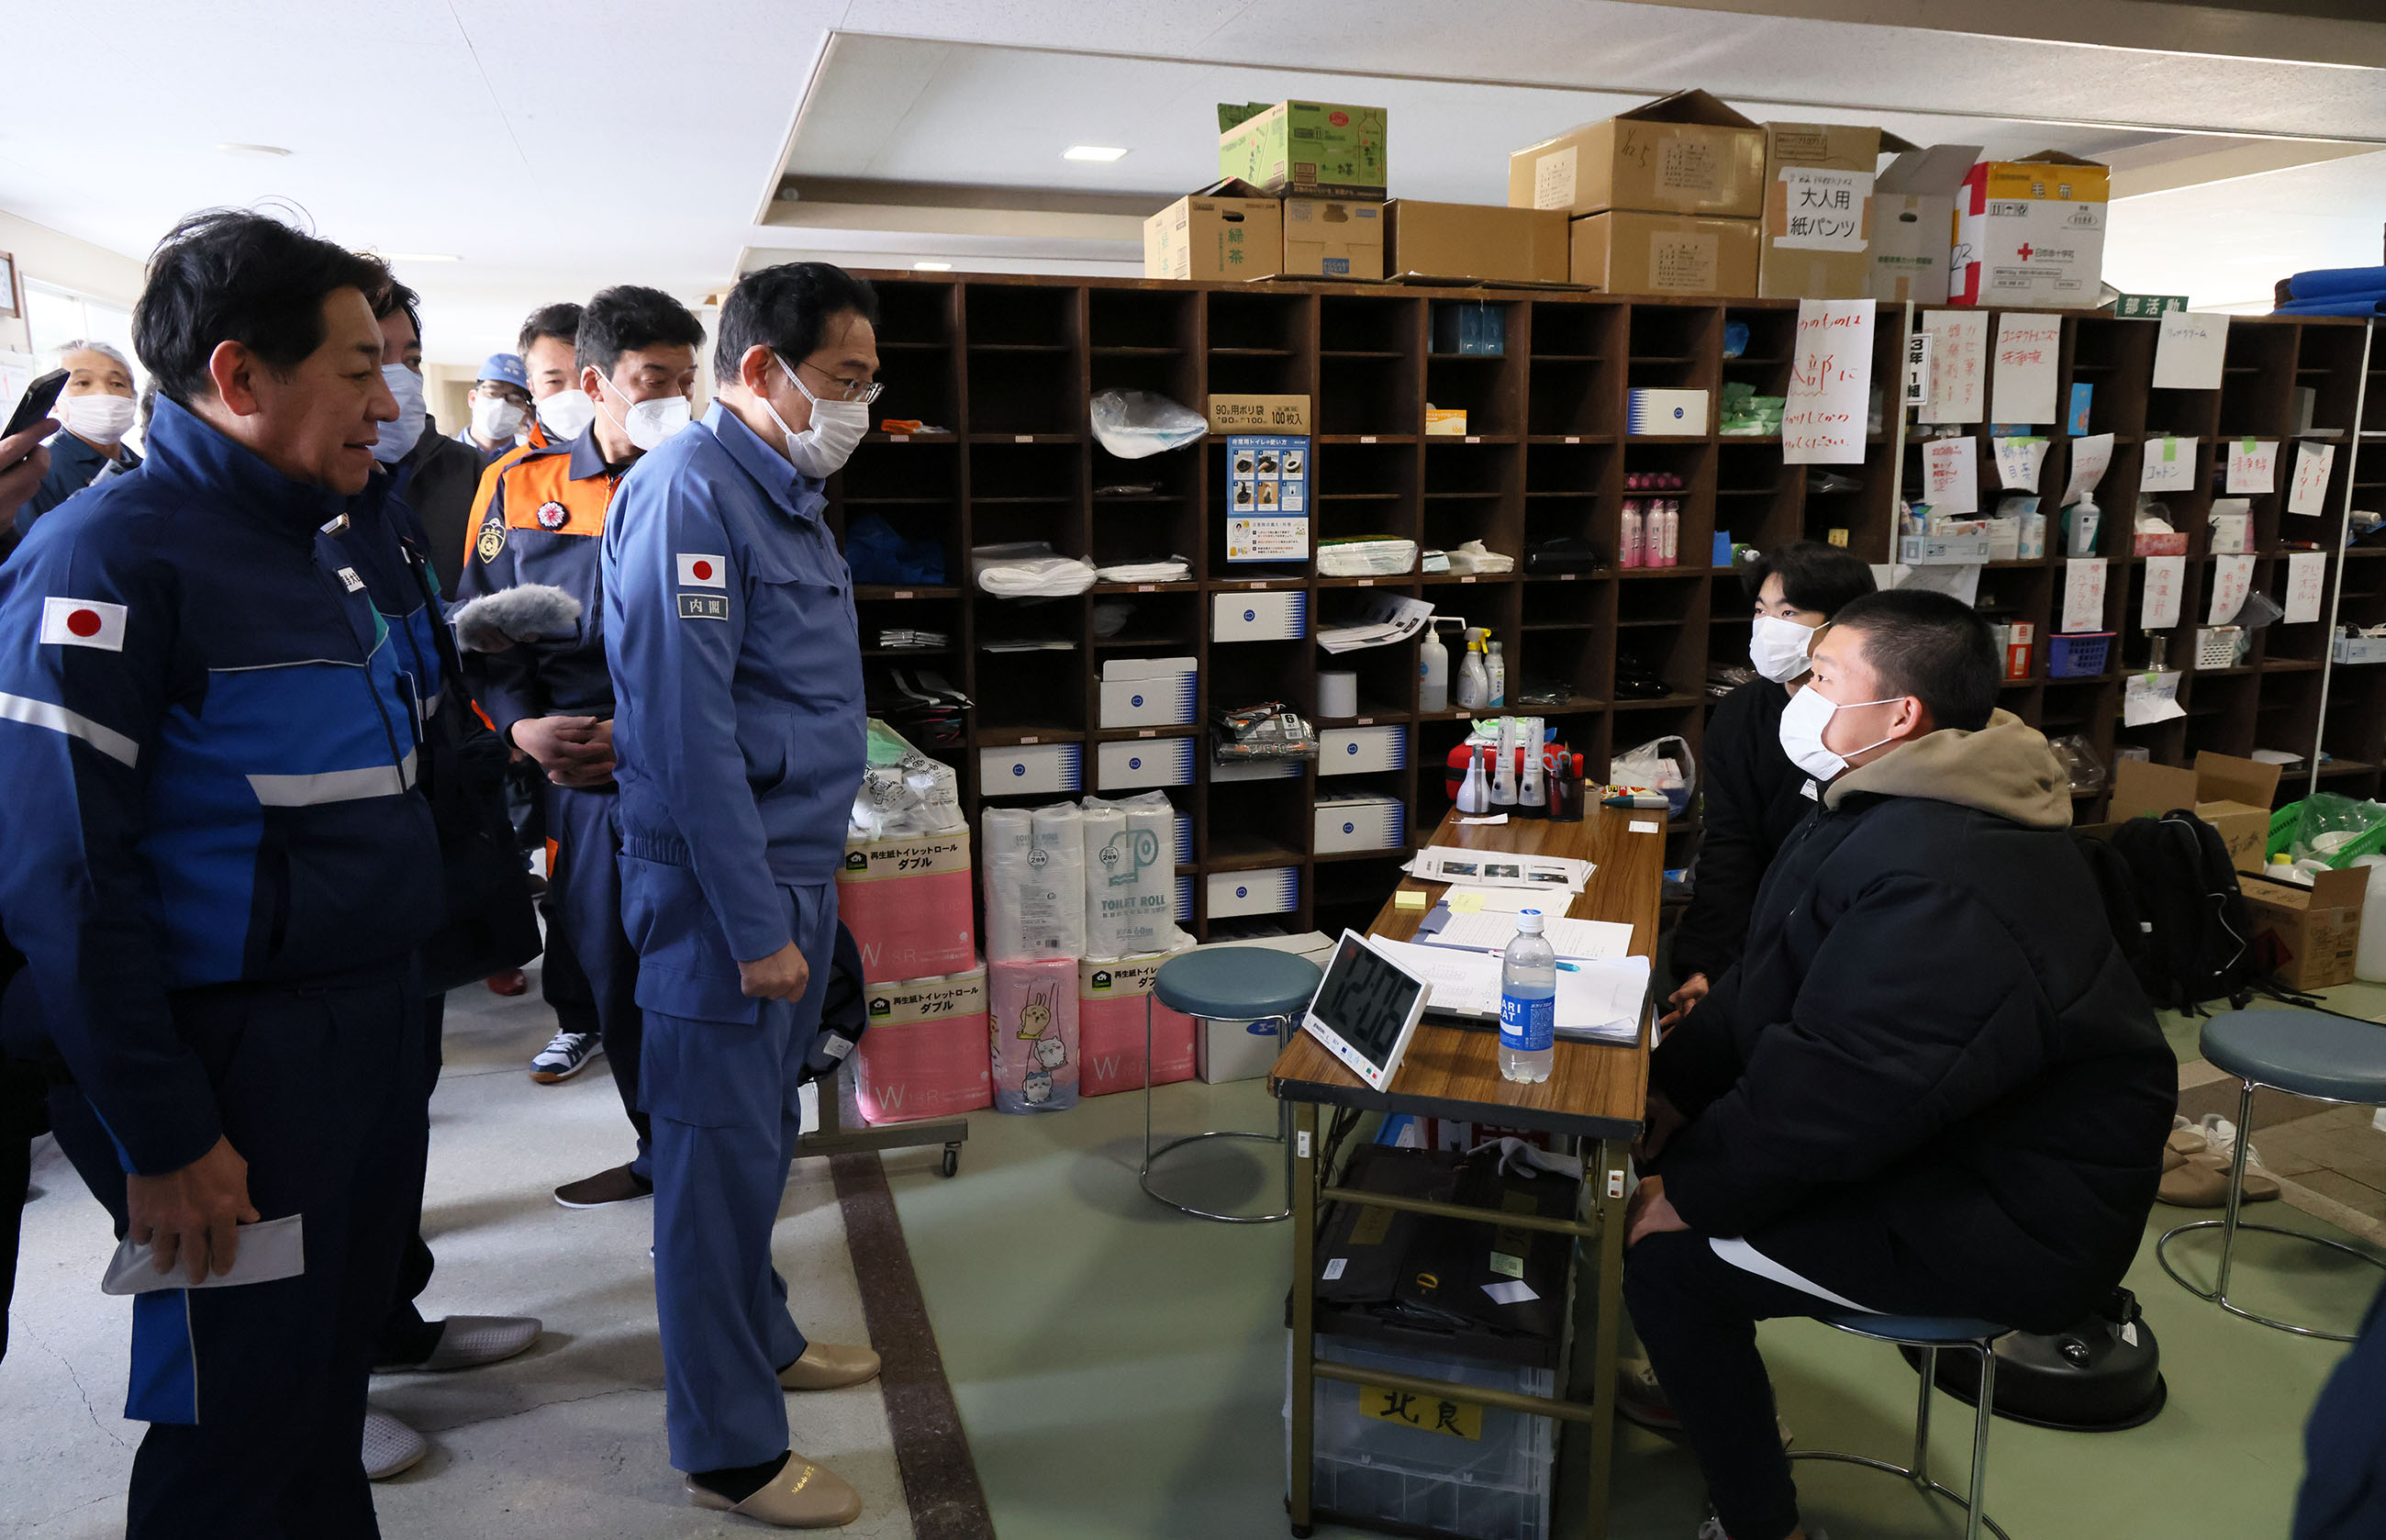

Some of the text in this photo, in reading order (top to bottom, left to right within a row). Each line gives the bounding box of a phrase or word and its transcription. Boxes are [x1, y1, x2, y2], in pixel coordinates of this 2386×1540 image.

[1801, 186, 1851, 210] 大人用
[2031, 183, 2072, 199] 毛布
[1790, 216, 1856, 238] 紙パンツ
[1227, 228, 1244, 265] 緑茶
[2124, 296, 2180, 315] 部活動
[689, 598, 720, 614] 内閣
[870, 843, 958, 860] 再生紙トイレットロール
[898, 856, 932, 871] ダブル
[1100, 894, 1165, 910] TOILET ROLL
[893, 987, 979, 1006] 再生紙トイレットロール
[920, 1000, 954, 1014] ダブル
[1092, 1055, 1121, 1080] W
[875, 1084, 906, 1110] W
